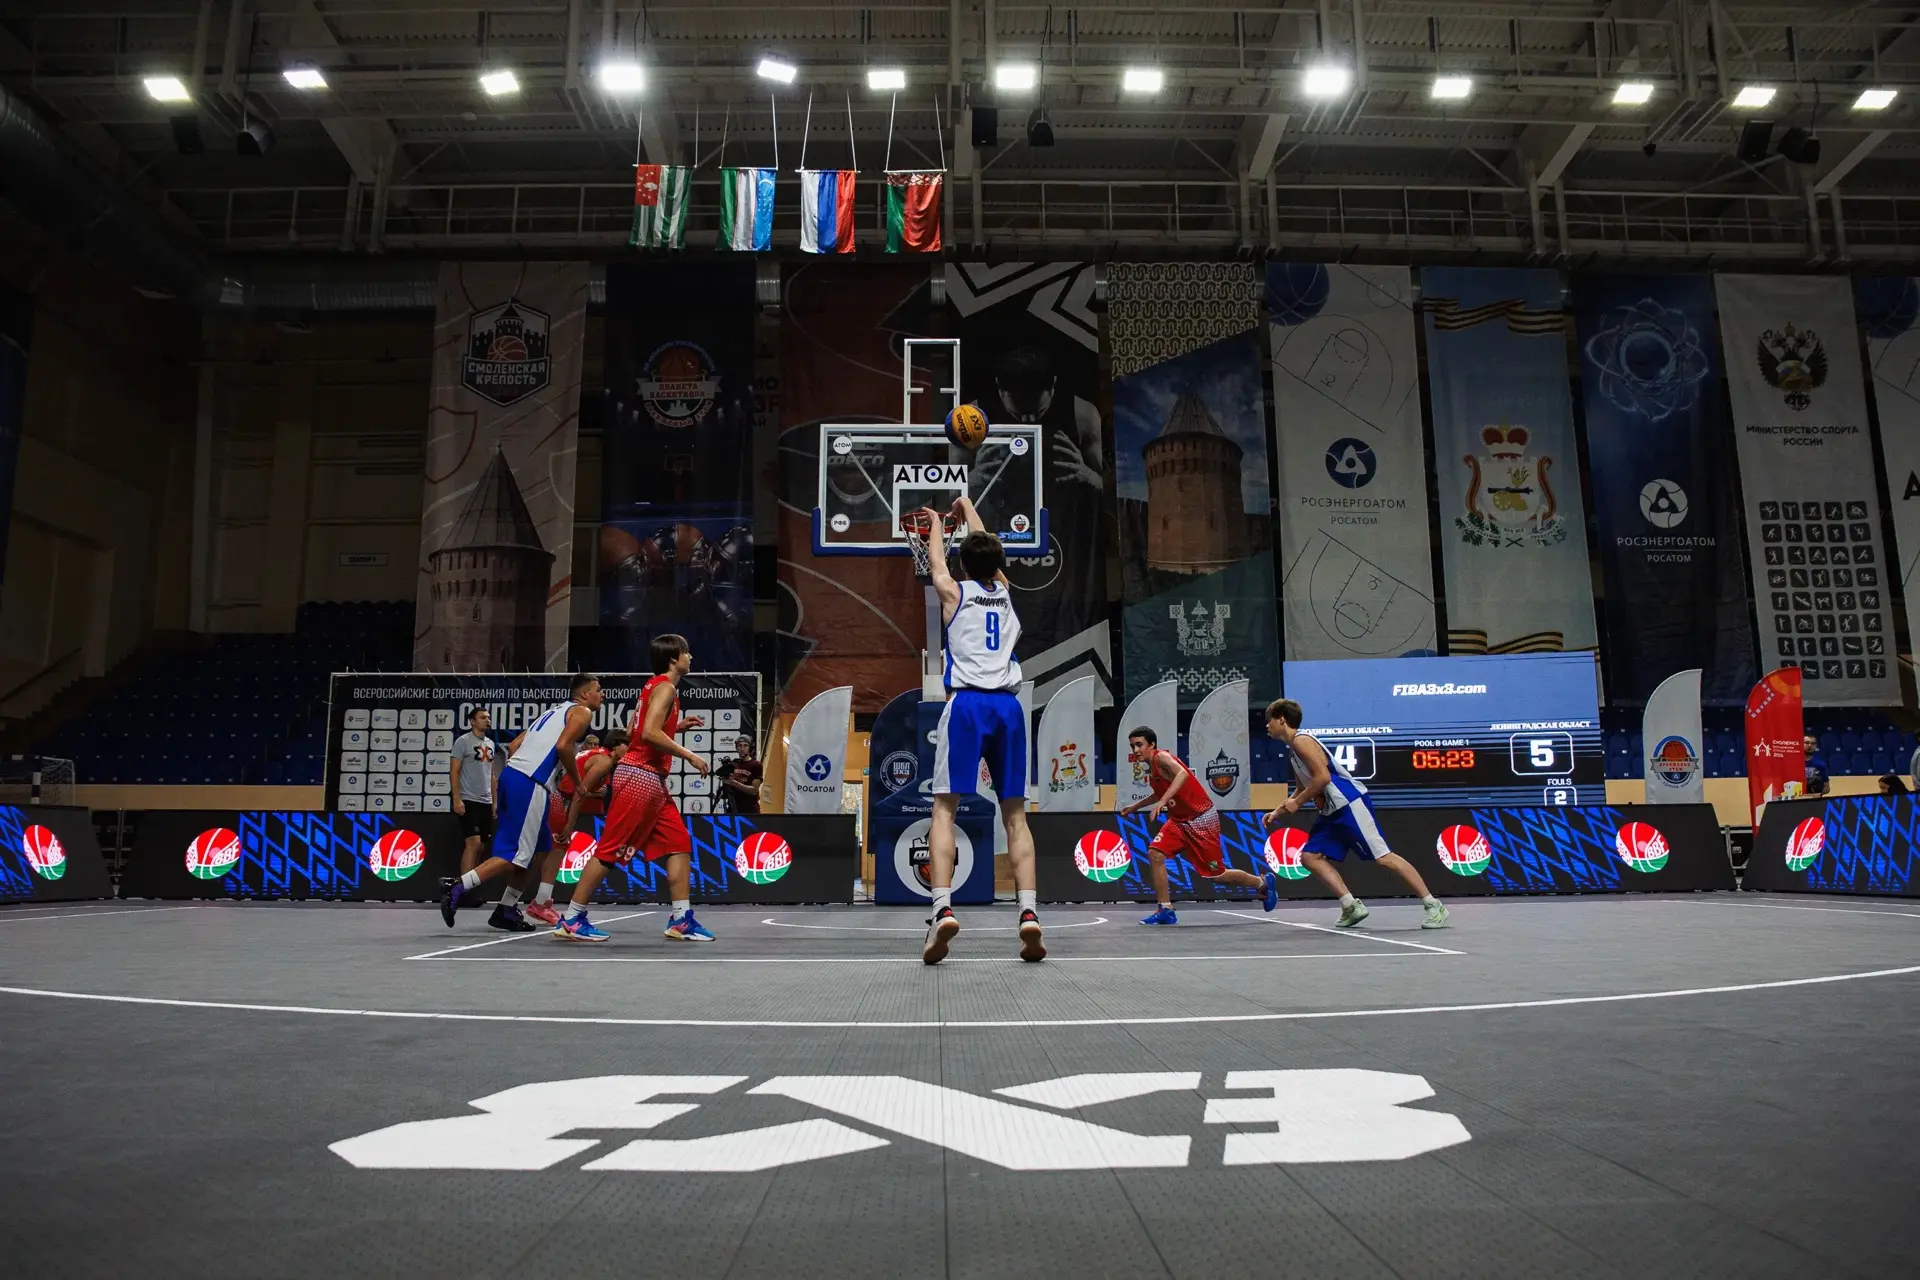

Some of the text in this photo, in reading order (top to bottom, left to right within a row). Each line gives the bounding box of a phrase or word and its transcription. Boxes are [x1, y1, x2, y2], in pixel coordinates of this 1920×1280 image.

[468, 361, 545, 373] СМОЛЕНСКАЯ
[476, 374, 536, 385] КРЕПОСТЬ
[1746, 426, 1859, 434] МИНИСТЕРСТВО СПОРТА
[1783, 438, 1823, 446] РОССИИ
[1301, 496, 1406, 509] РОСЭНЕРГОАТОМ
[1331, 516, 1378, 525] РОСАТОМ
[1617, 536, 1716, 547] РОСЭНЕРГОАТОМ
[1647, 554, 1692, 563] РОСАТОМ
[986, 611, 999, 651] 9
[353, 686, 430, 699] ВСЕРОССИЙСКИЕ
[432, 687, 505, 699] СОРЕВНОВАНИЯ
[507, 688, 520, 699] ПО
[683, 688, 740, 699] «РОСАТОМ»
[1393, 683, 1487, 696] FIBA3x3.com
[1355, 726, 1393, 735] ОБЛАСТЬ
[1490, 722, 1558, 731] ЛЕНИНГРАДСКАЯ
[1334, 745, 1358, 772] 4
[1412, 750, 1475, 769] 05:23
[1530, 739, 1555, 767] 5
[797, 784, 835, 793] РОСАТОМ
[1547, 778, 1572, 786] FOULS
[1554, 790, 1568, 805] 2
[901, 805, 933, 813] Scheld
[1469, 839, 1487, 862] BBF
[1648, 835, 1665, 858] BBF
[217, 843, 239, 865] BBF
[399, 843, 423, 867] BBF
[766, 845, 789, 869] BBF
[1107, 843, 1128, 868] BBF
